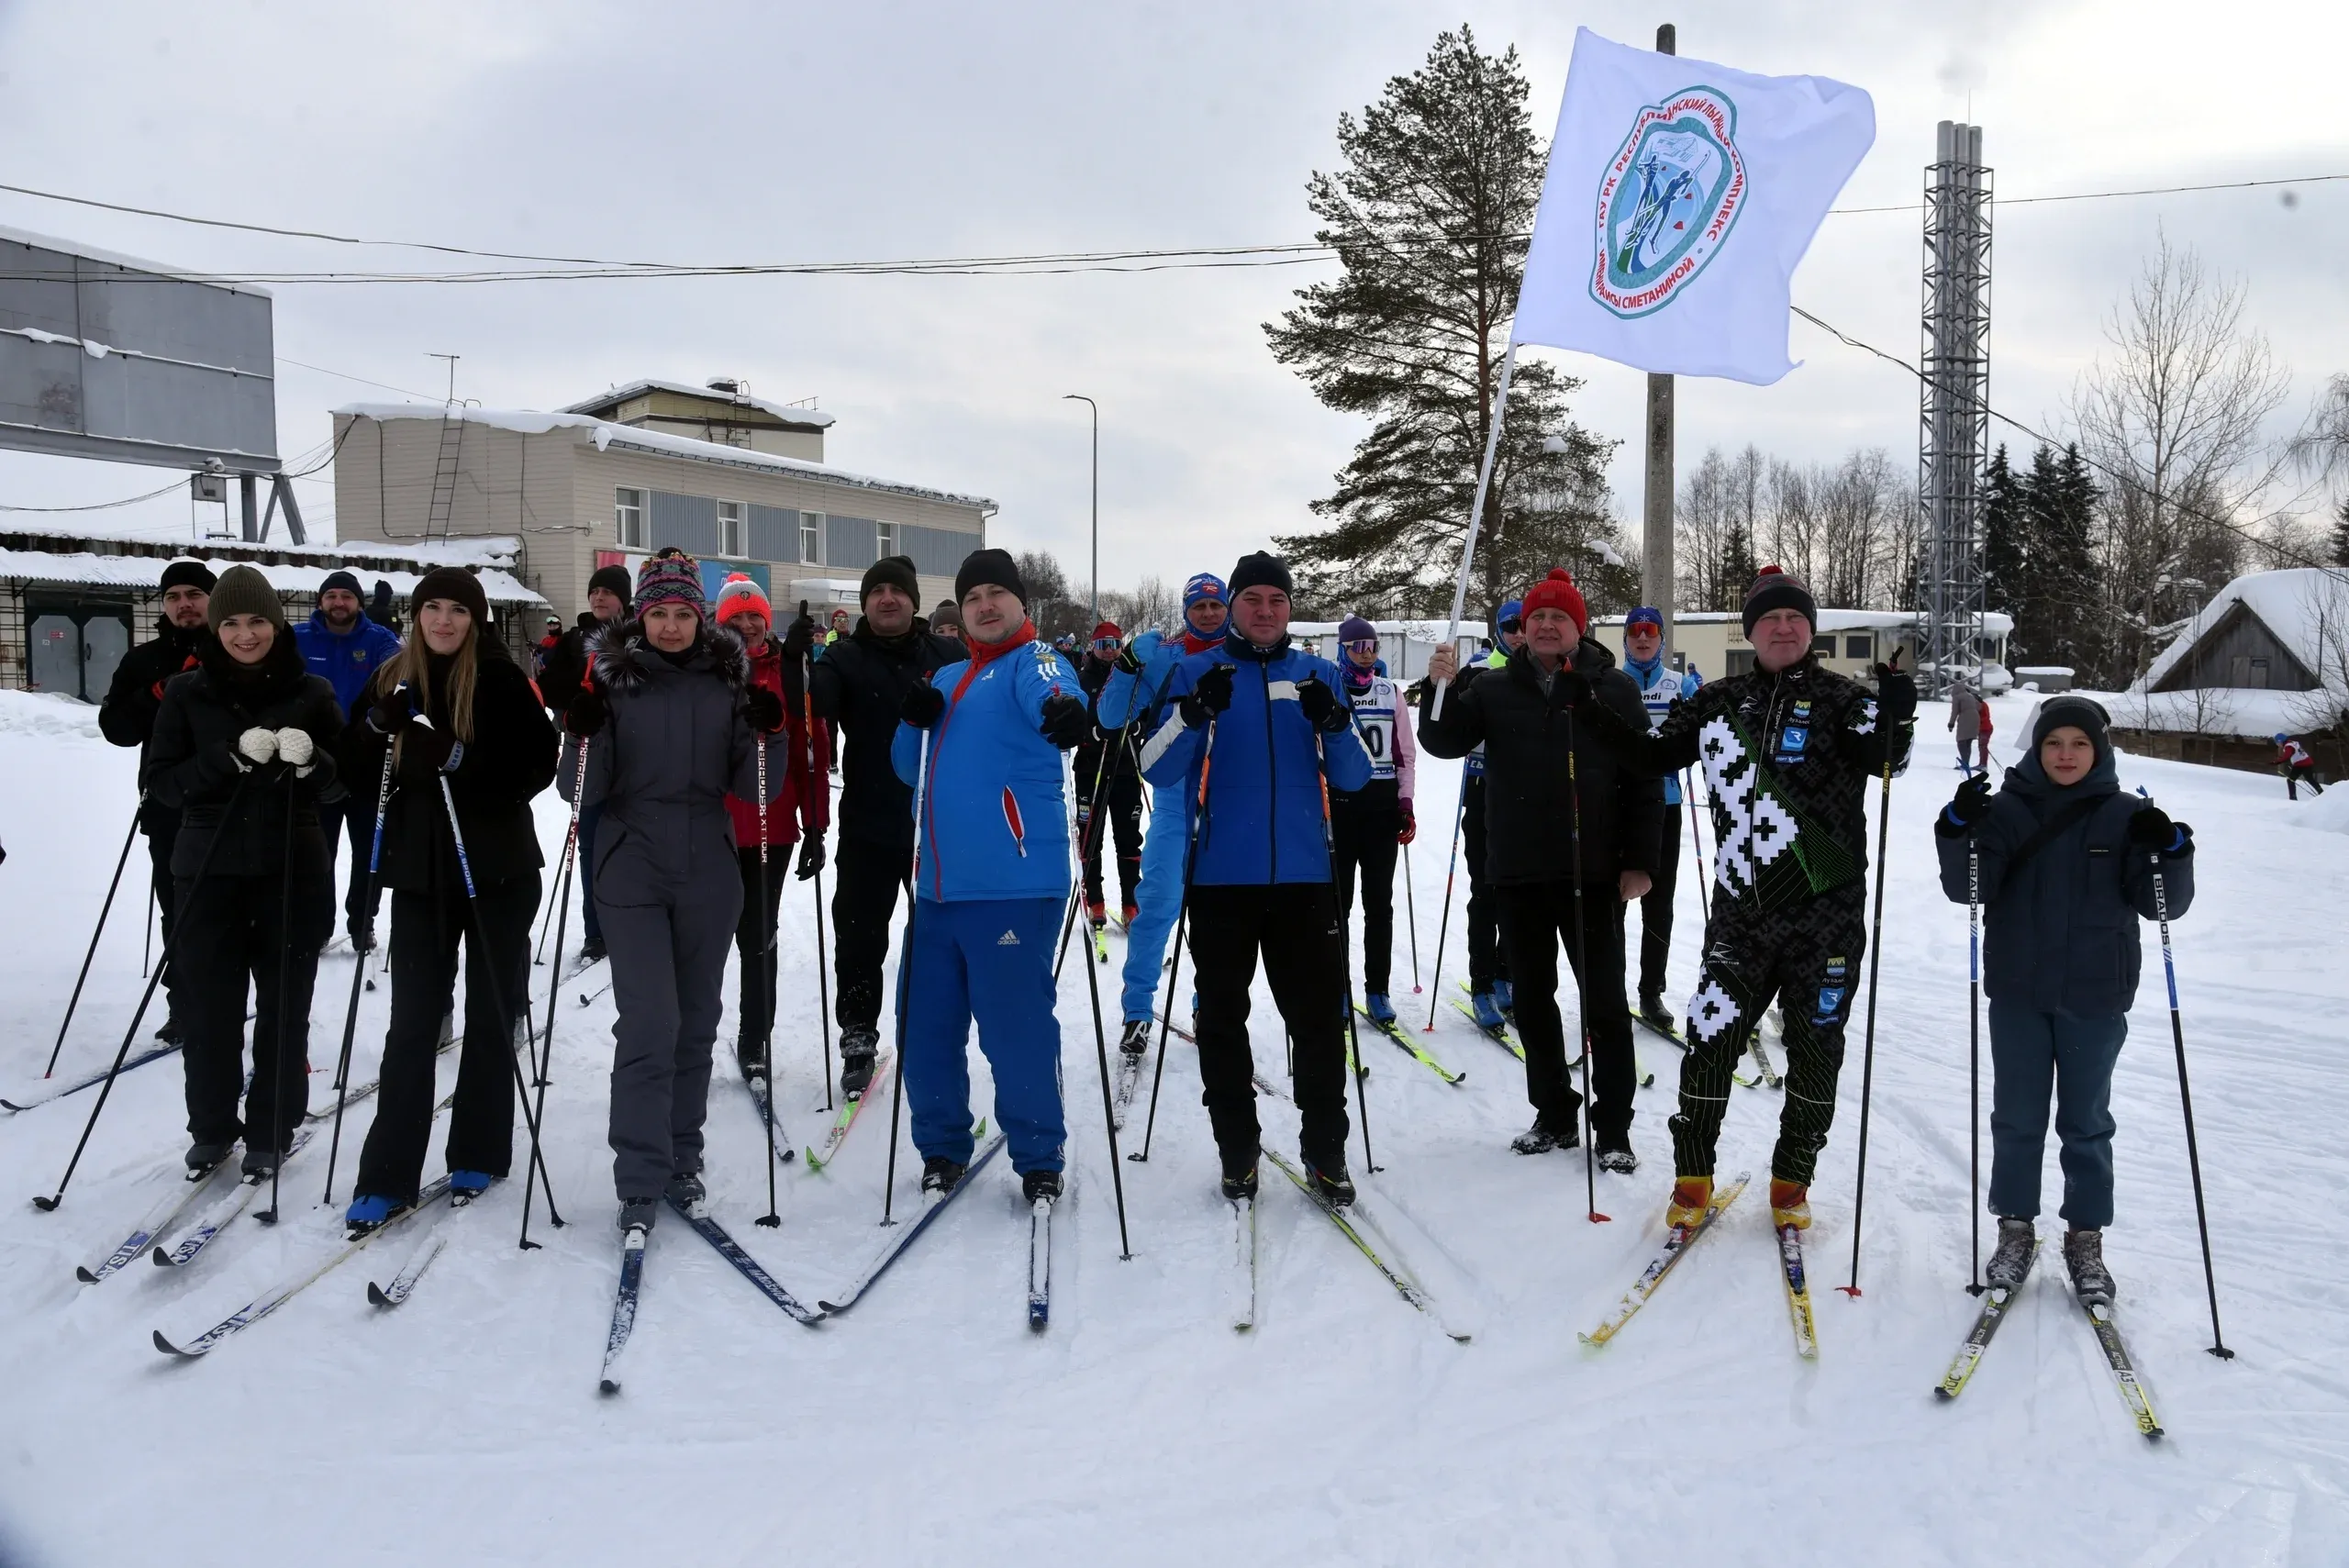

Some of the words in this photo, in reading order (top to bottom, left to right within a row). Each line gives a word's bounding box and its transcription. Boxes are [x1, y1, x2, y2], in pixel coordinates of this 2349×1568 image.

[1615, 98, 1709, 172] РЕСПУБЛИАНСКИЙ
[1702, 104, 1731, 150] ЛЫЖНЫЙ
[1603, 177, 1617, 197] РК
[1707, 149, 1744, 241] КОМПЛЕКС
[1598, 202, 1607, 228] ГАУ
[1596, 283, 1621, 308] РАИСЫ
[1622, 256, 1696, 309] СМЕТАНИНОЙ
[1642, 692, 1662, 701] ndi
[1775, 698, 1786, 729] VICTORY
[379, 751, 393, 814] BRADOS
[761, 818, 767, 831] XT
[461, 857, 473, 890] SPORT
[2154, 878, 2170, 945] BRADOS
[99, 1243, 141, 1281] TISA
[2111, 1351, 2126, 1370] ACTIVE
[2118, 1371, 2135, 1384] A3
